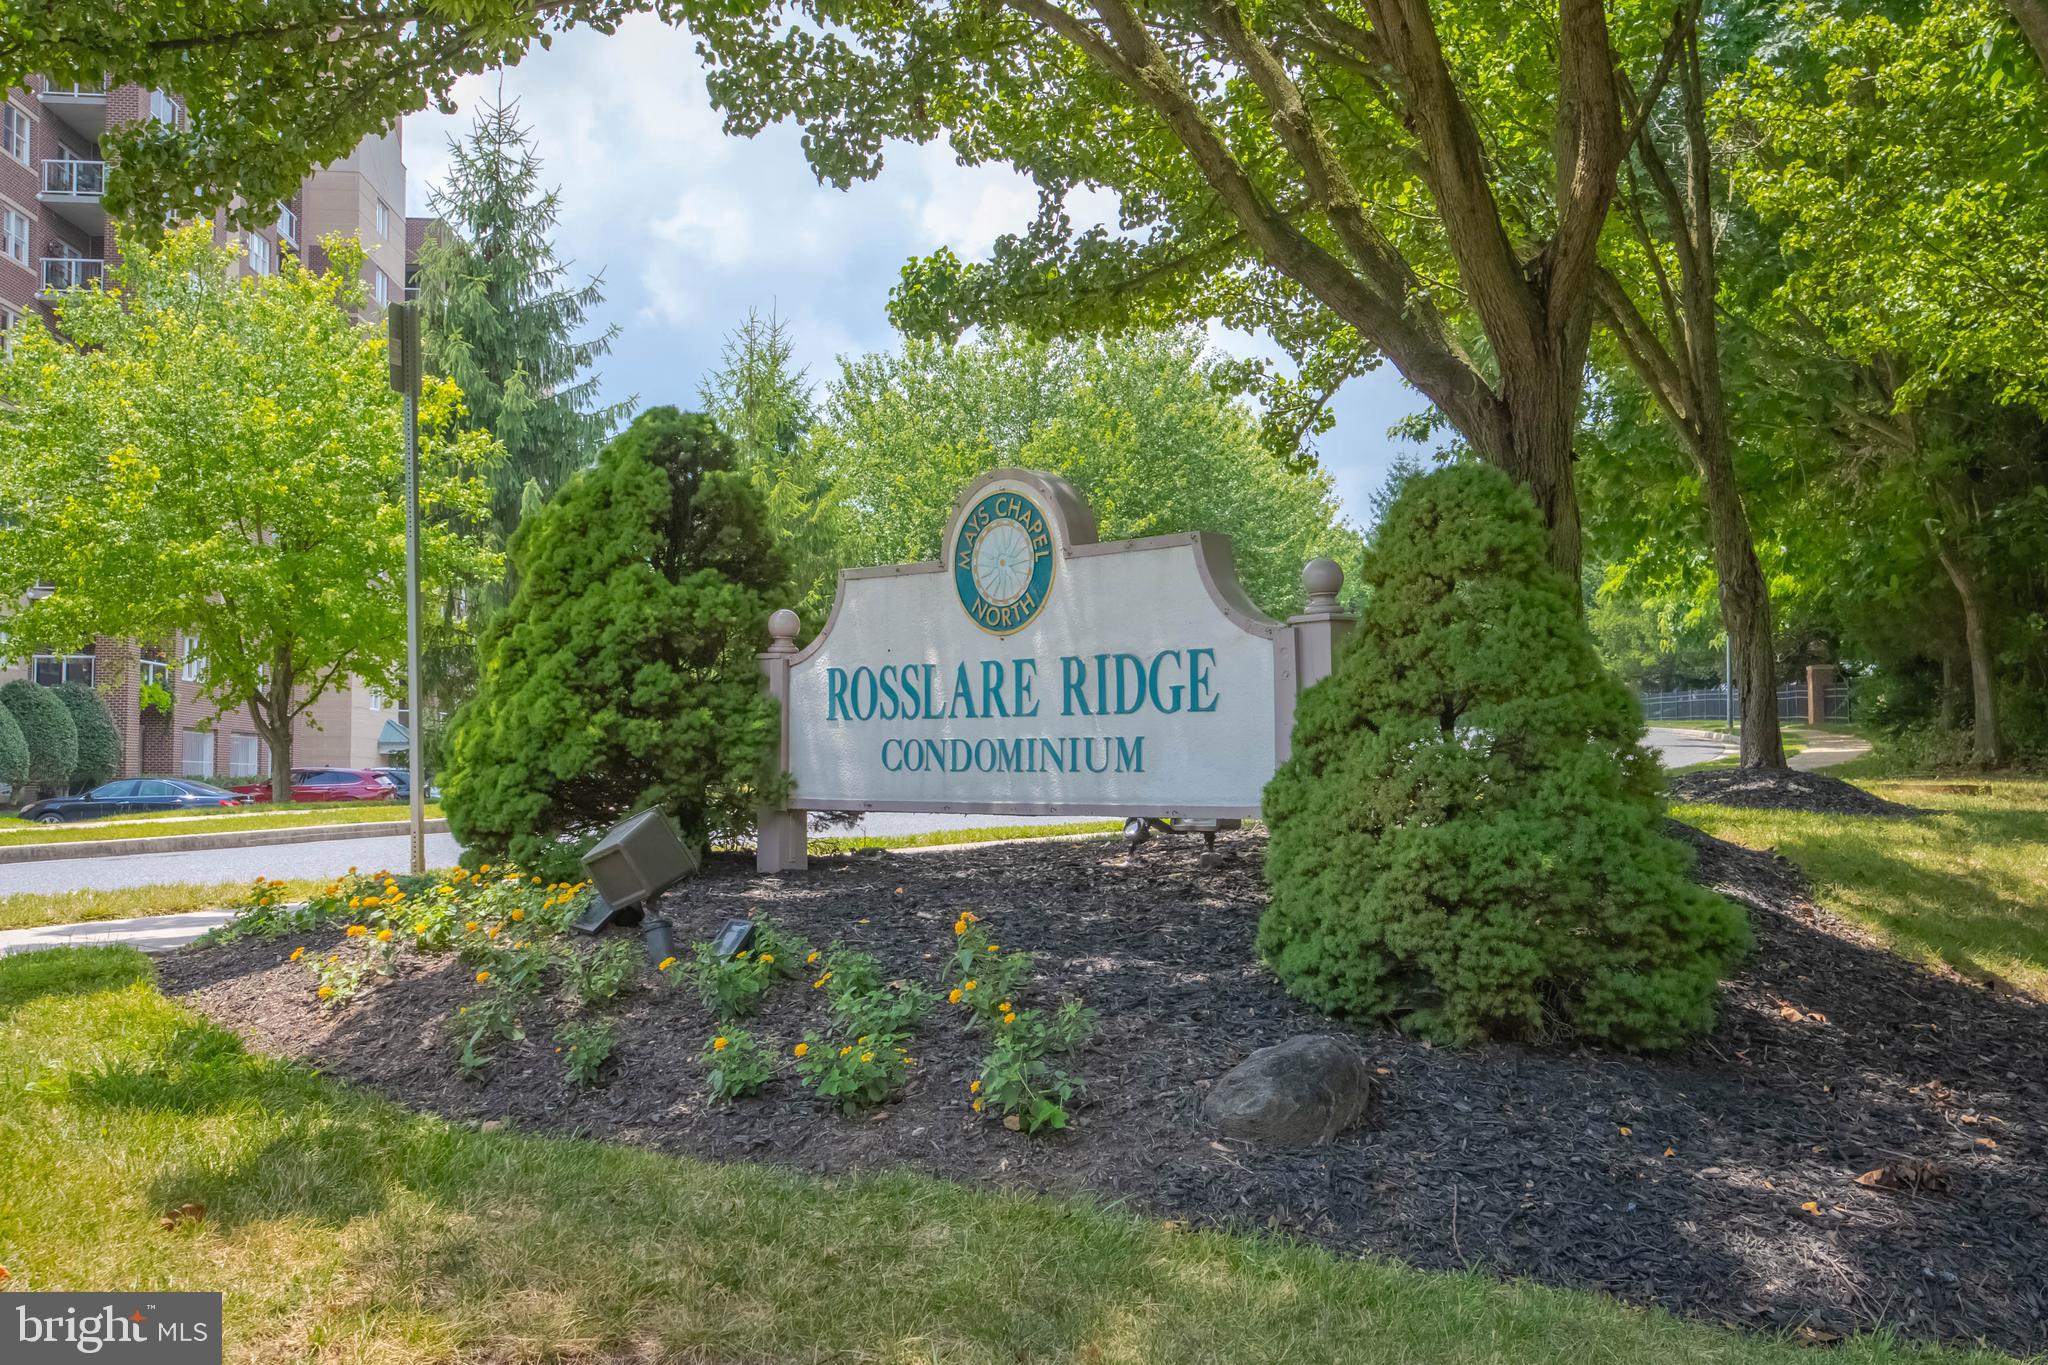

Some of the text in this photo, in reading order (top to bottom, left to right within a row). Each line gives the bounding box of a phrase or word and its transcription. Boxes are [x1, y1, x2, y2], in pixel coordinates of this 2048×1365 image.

[959, 497, 1050, 571] MAYS CHAPEL
[971, 592, 1036, 627] NORTH
[826, 648, 1221, 722] ROSSLARE RIDGE
[881, 736, 1146, 775] CONDOMINIUM
